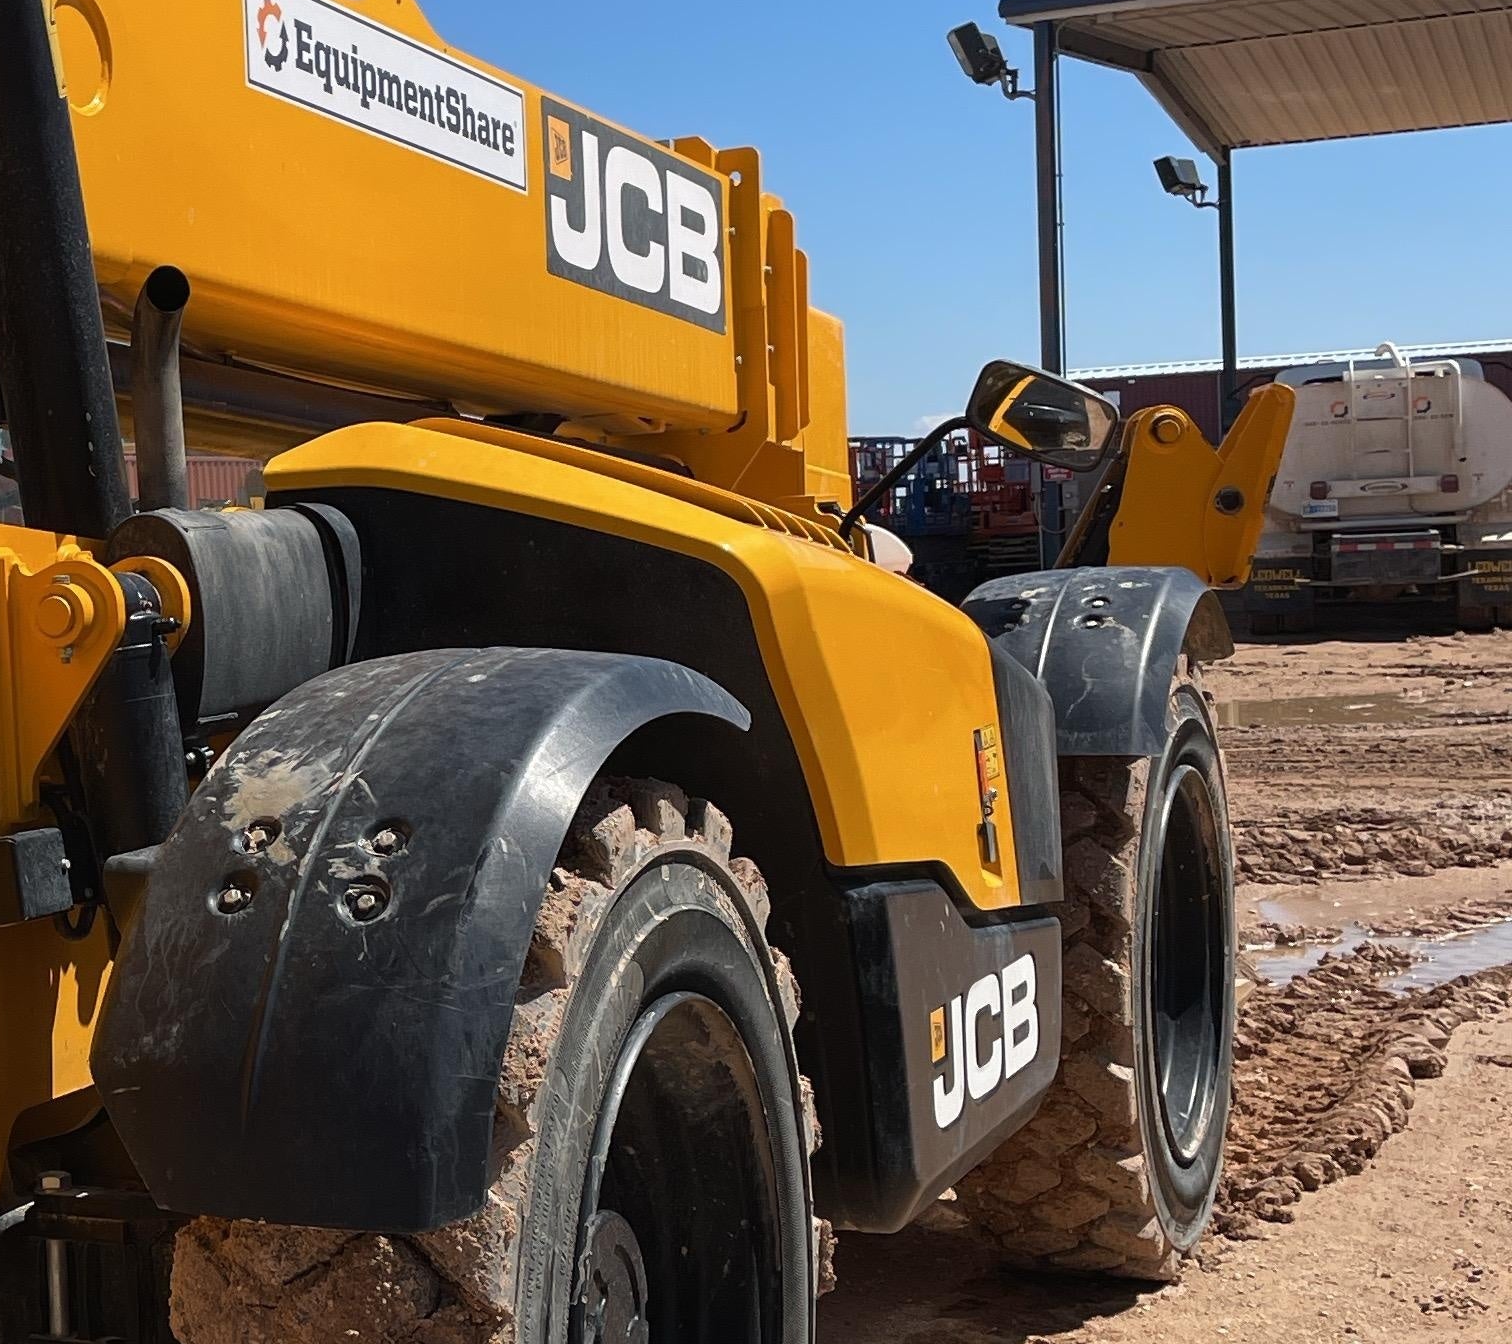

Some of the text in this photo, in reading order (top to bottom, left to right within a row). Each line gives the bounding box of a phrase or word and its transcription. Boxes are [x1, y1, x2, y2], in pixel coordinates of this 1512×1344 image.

[292, 18, 515, 157] EquipmentShare
[550, 130, 722, 315] JCB
[933, 953, 1039, 1130] JCB
